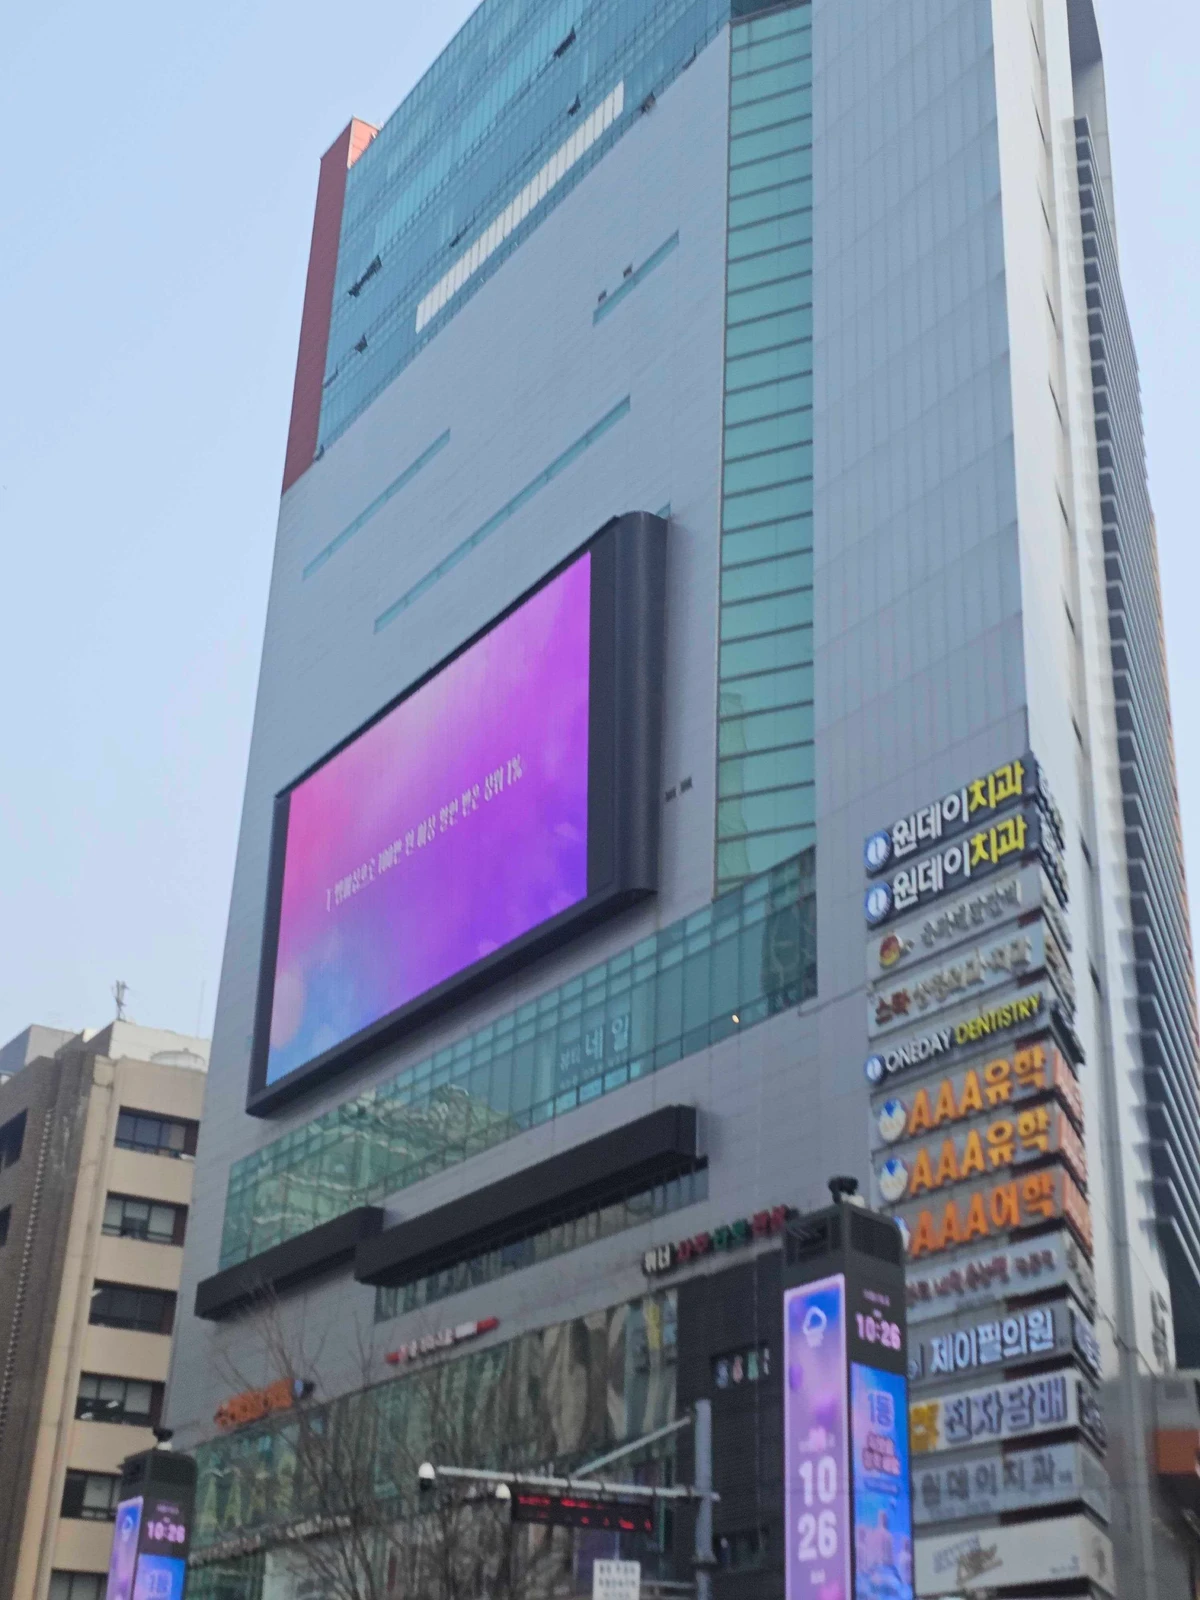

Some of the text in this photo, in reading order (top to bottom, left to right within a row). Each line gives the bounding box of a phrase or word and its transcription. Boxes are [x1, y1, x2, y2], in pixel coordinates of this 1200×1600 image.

[891, 759, 1025, 859] 원데이치과
[892, 813, 1028, 911] 원데이치과
[884, 991, 1043, 1073] ONEDAY DENTISTRY
[908, 1044, 1047, 1137] AAA유학
[909, 1104, 1051, 1195] AAA유학
[910, 1172, 1056, 1258] AAA어학
[855, 1311, 901, 1351] 10:26
[930, 1307, 1055, 1374] 제이필의원
[943, 1376, 1068, 1443] 전자담배
[798, 1455, 837, 1507] 10
[797, 1508, 838, 1562] 26
